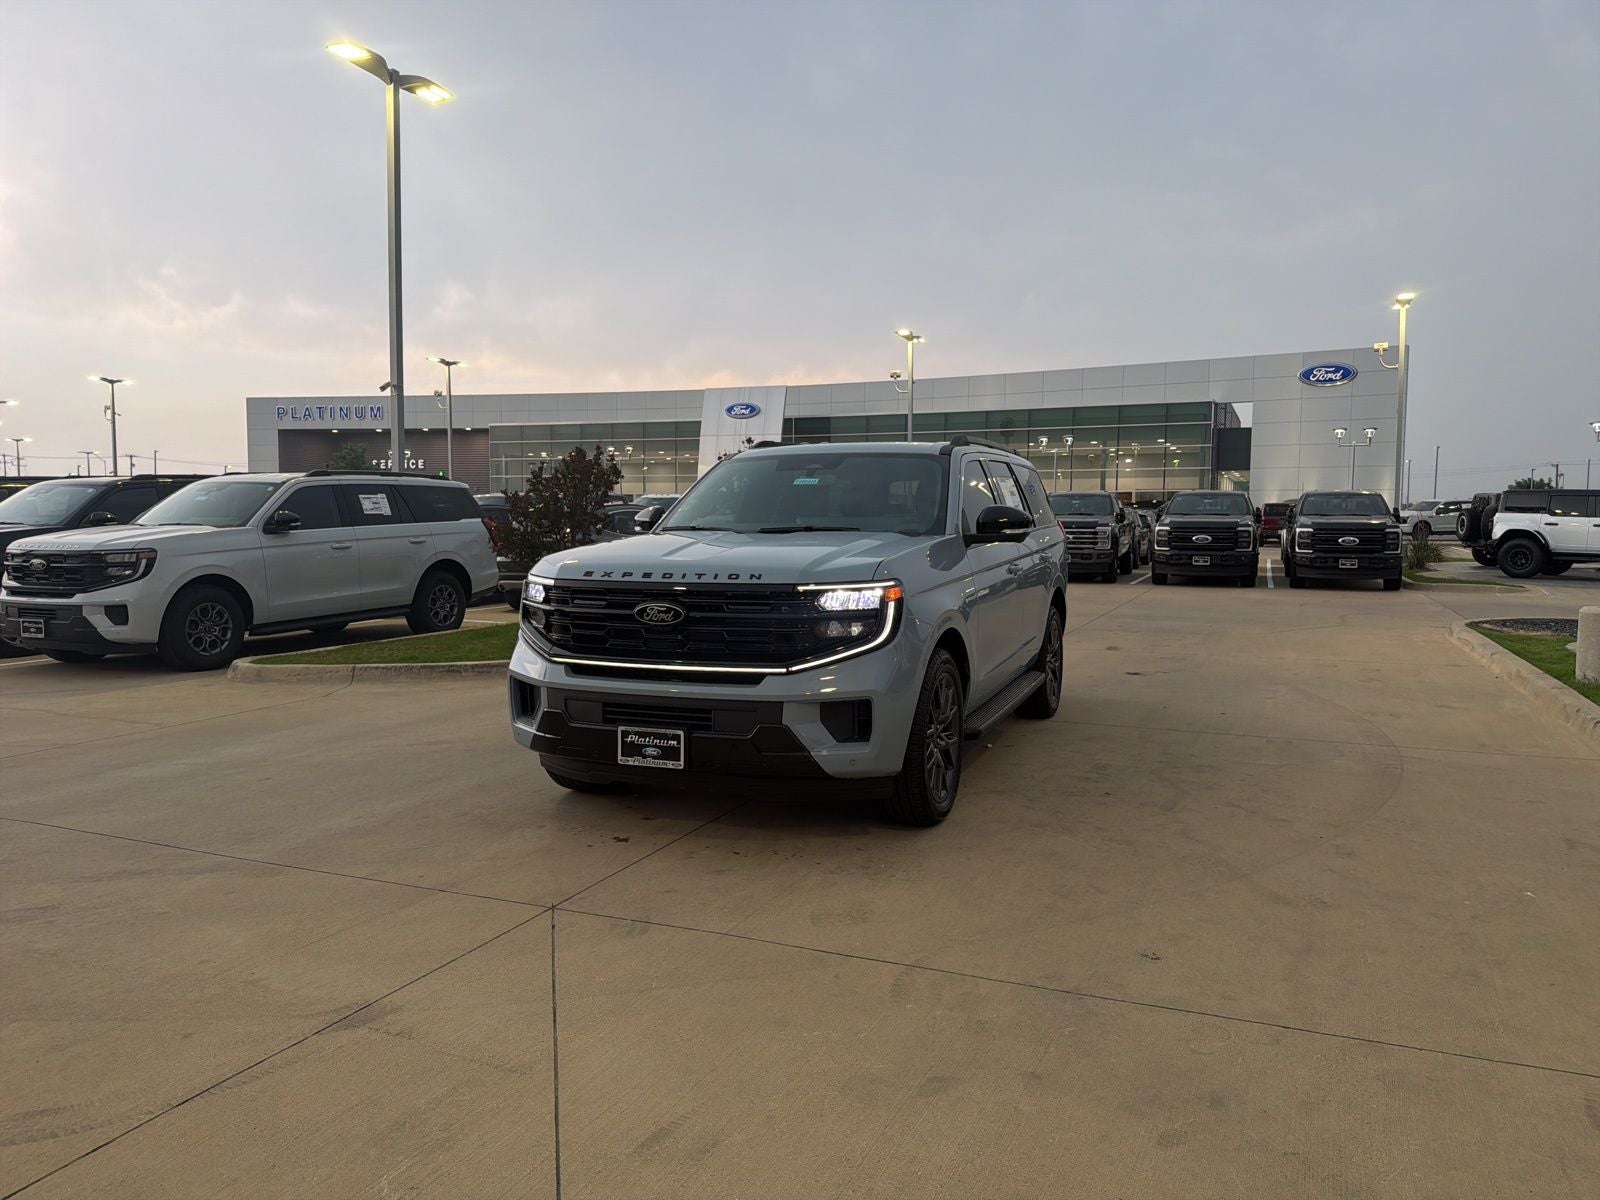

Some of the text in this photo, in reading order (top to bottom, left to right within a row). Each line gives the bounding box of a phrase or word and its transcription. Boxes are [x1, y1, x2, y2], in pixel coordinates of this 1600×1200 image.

[1310, 367, 1344, 381] Ford
[276, 405, 384, 421] PLATINUM
[731, 405, 751, 415] Ford
[583, 570, 763, 581] EXPEDITION
[643, 606, 675, 622] Ford
[624, 735, 680, 747] Platinum
